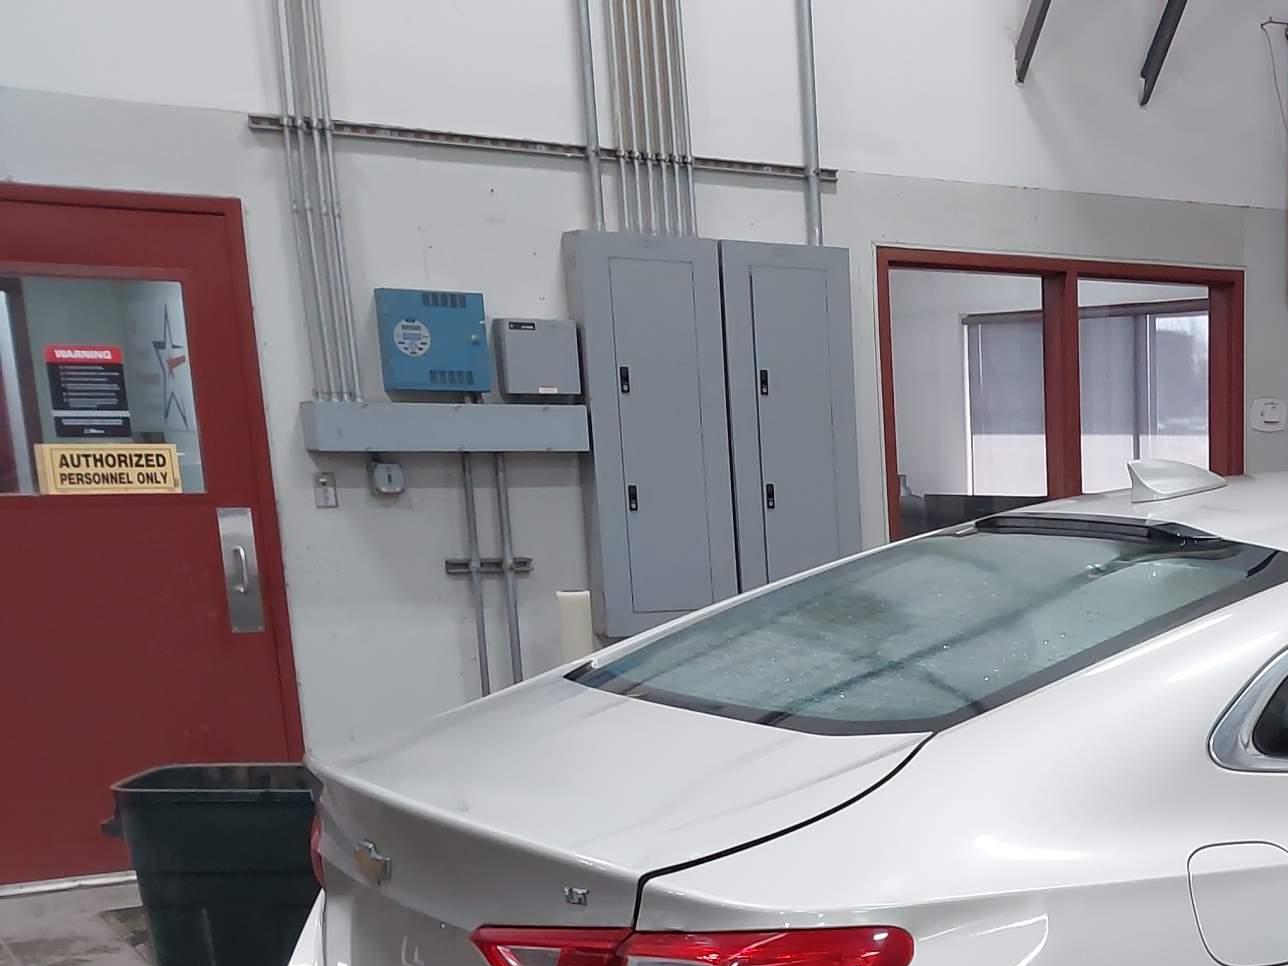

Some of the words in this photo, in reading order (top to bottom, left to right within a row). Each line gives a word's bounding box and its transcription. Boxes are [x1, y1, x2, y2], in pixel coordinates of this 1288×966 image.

[54, 349, 112, 359] WARNING
[59, 454, 166, 468] AUTHORIZED
[60, 472, 133, 485] PERSONNEL
[137, 472, 168, 484] ONLY
